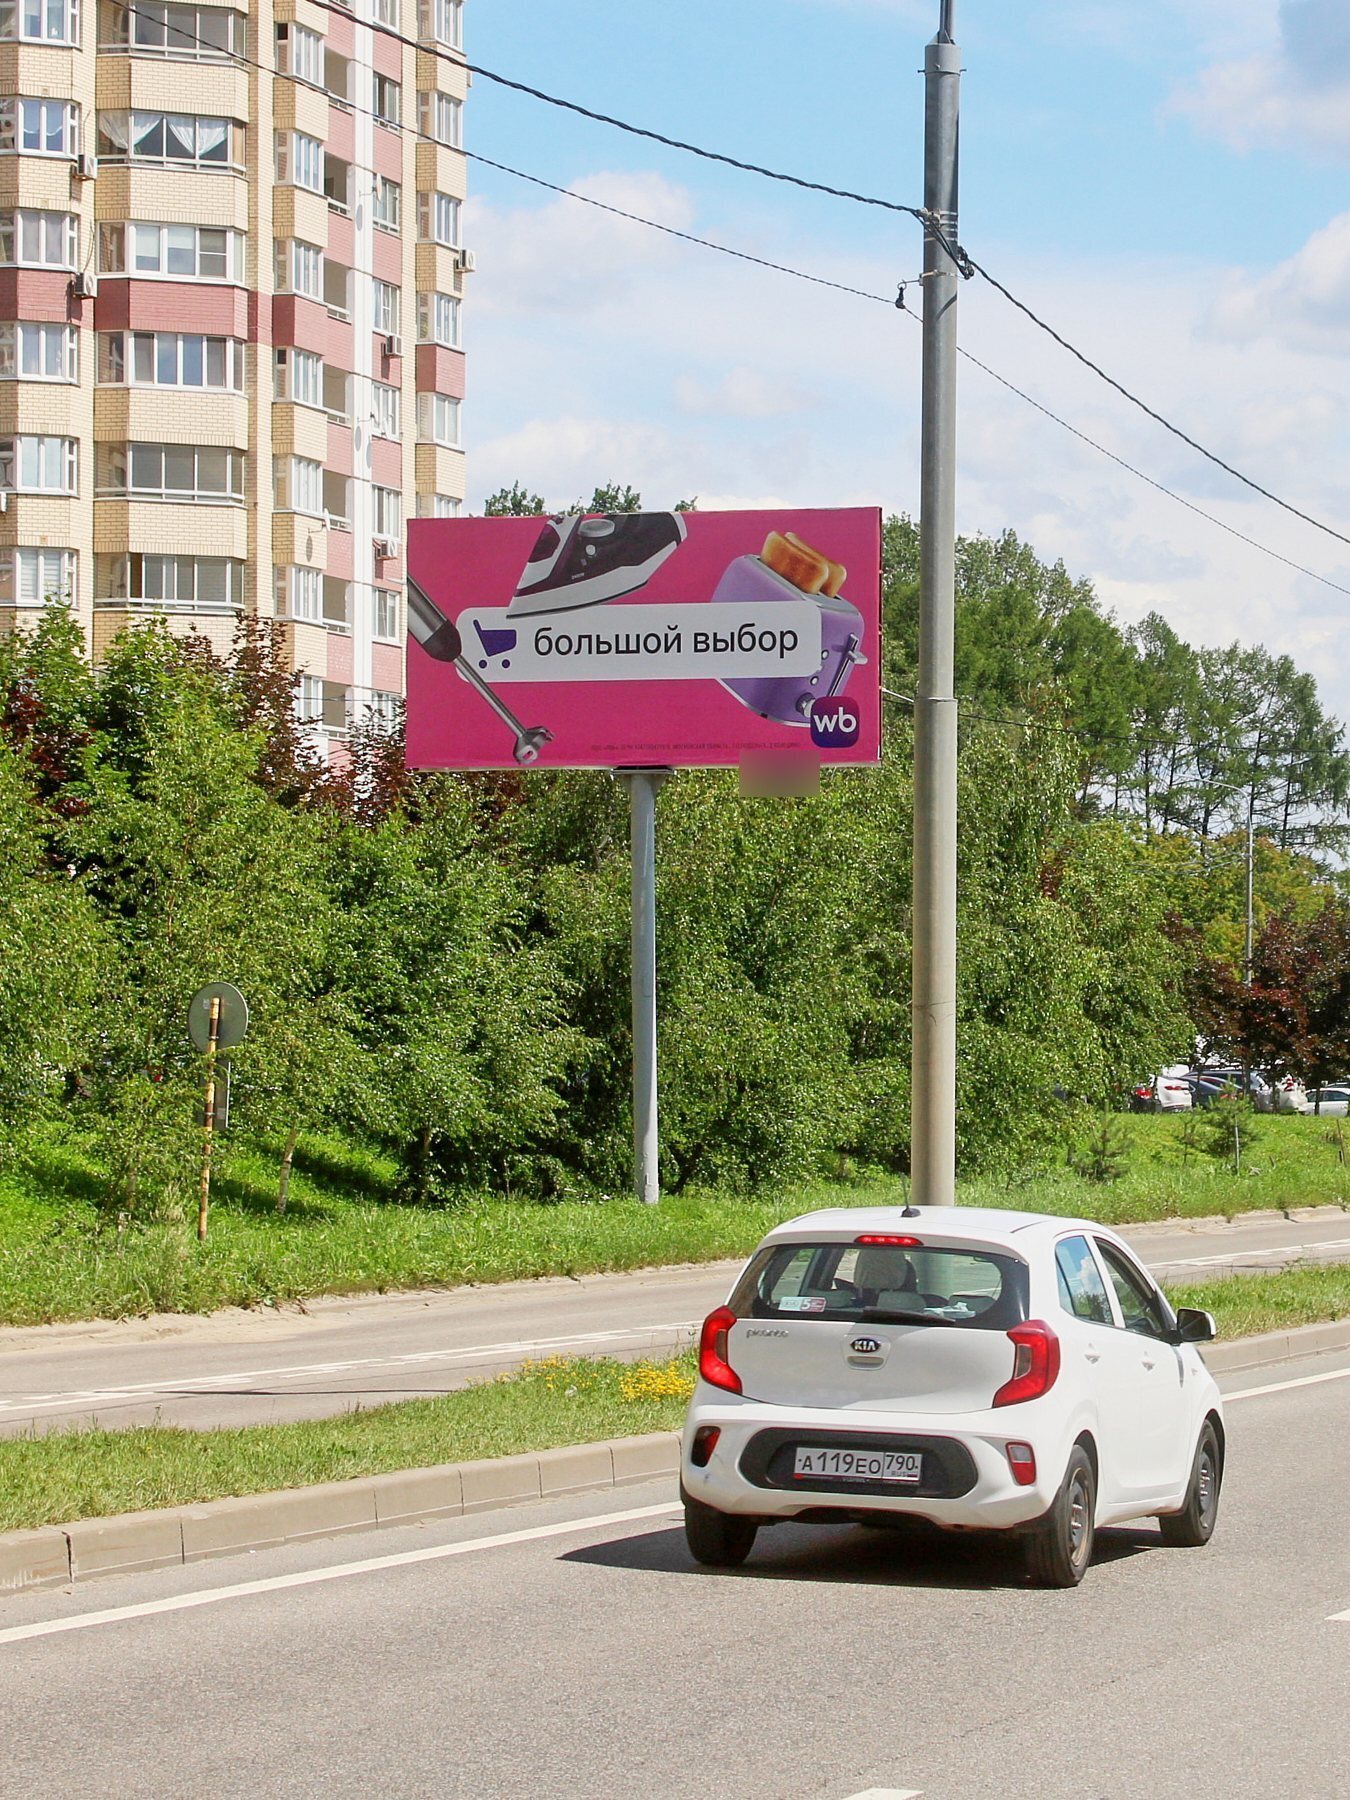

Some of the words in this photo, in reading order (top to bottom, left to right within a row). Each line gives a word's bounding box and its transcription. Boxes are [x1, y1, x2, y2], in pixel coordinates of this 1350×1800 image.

[534, 625, 682, 655] большой
[693, 623, 798, 659] выбор
[813, 706, 857, 733] wb
[854, 1340, 877, 1351] KIA
[886, 1454, 916, 1471] 790
